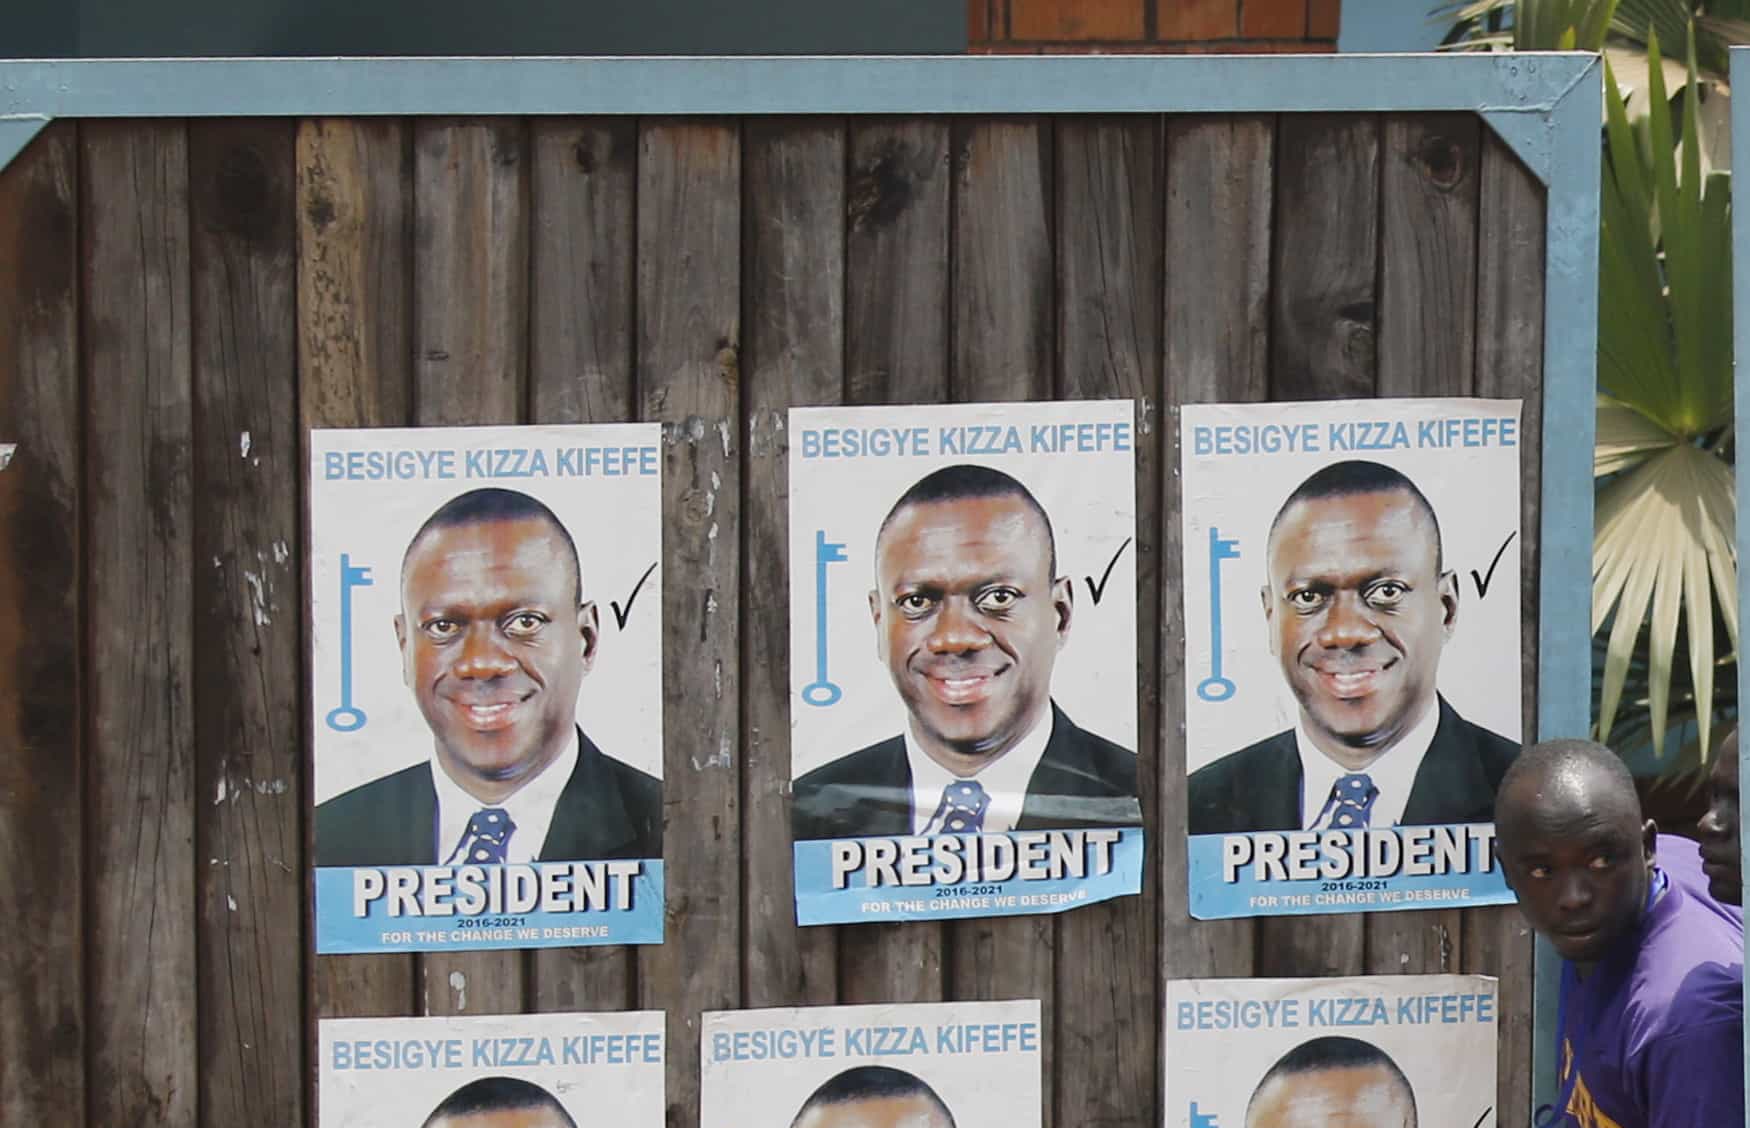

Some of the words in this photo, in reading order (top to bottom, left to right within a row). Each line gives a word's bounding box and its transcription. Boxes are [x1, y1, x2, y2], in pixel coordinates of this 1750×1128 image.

[802, 426, 929, 458] BESIGYE
[939, 424, 1022, 455] KIZZA
[1031, 422, 1129, 453] KIFEFE
[1194, 424, 1319, 454] BESIGYE
[1329, 420, 1409, 450] KIZZA
[1418, 417, 1515, 448] KIFEFE
[325, 450, 454, 480] BESIGYE
[466, 448, 549, 478] KIZZA
[557, 446, 657, 476] KIFEFE
[832, 829, 1118, 890] PRESIDENT
[1223, 826, 1495, 883] PRESIDENT
[353, 860, 639, 918] PRESIDENT
[935, 882, 1002, 899] 2016-2021
[1250, 895, 1277, 907] FOR
[1282, 894, 1310, 906] THE
[1316, 891, 1375, 904] CHANGE
[1379, 890, 1400, 902] WE
[1405, 888, 1470, 901] DESERVE
[1321, 880, 1387, 891] 2016-2021
[457, 917, 525, 927] 2016-2021
[861, 901, 892, 915] FOR
[896, 899, 924, 913] THE
[929, 894, 990, 913] CHANGE
[994, 894, 1017, 907] WE
[382, 931, 412, 943] FOR
[416, 931, 446, 942] THE
[450, 929, 512, 941] CHANGE
[517, 928, 539, 939] WE
[544, 926, 608, 938] DESERVE
[1177, 1000, 1298, 1029] BESIGYE
[1308, 997, 1389, 1026] KIZZA
[1397, 994, 1493, 1023] KIFEFE
[332, 1038, 460, 1070] BESIGYE
[472, 1036, 554, 1067] KIZZA
[562, 1033, 660, 1065] KIFEFE
[713, 1028, 834, 1061] BESIGYE
[845, 1026, 927, 1056] KIZZA
[937, 1022, 1037, 1054] KIFEFE
